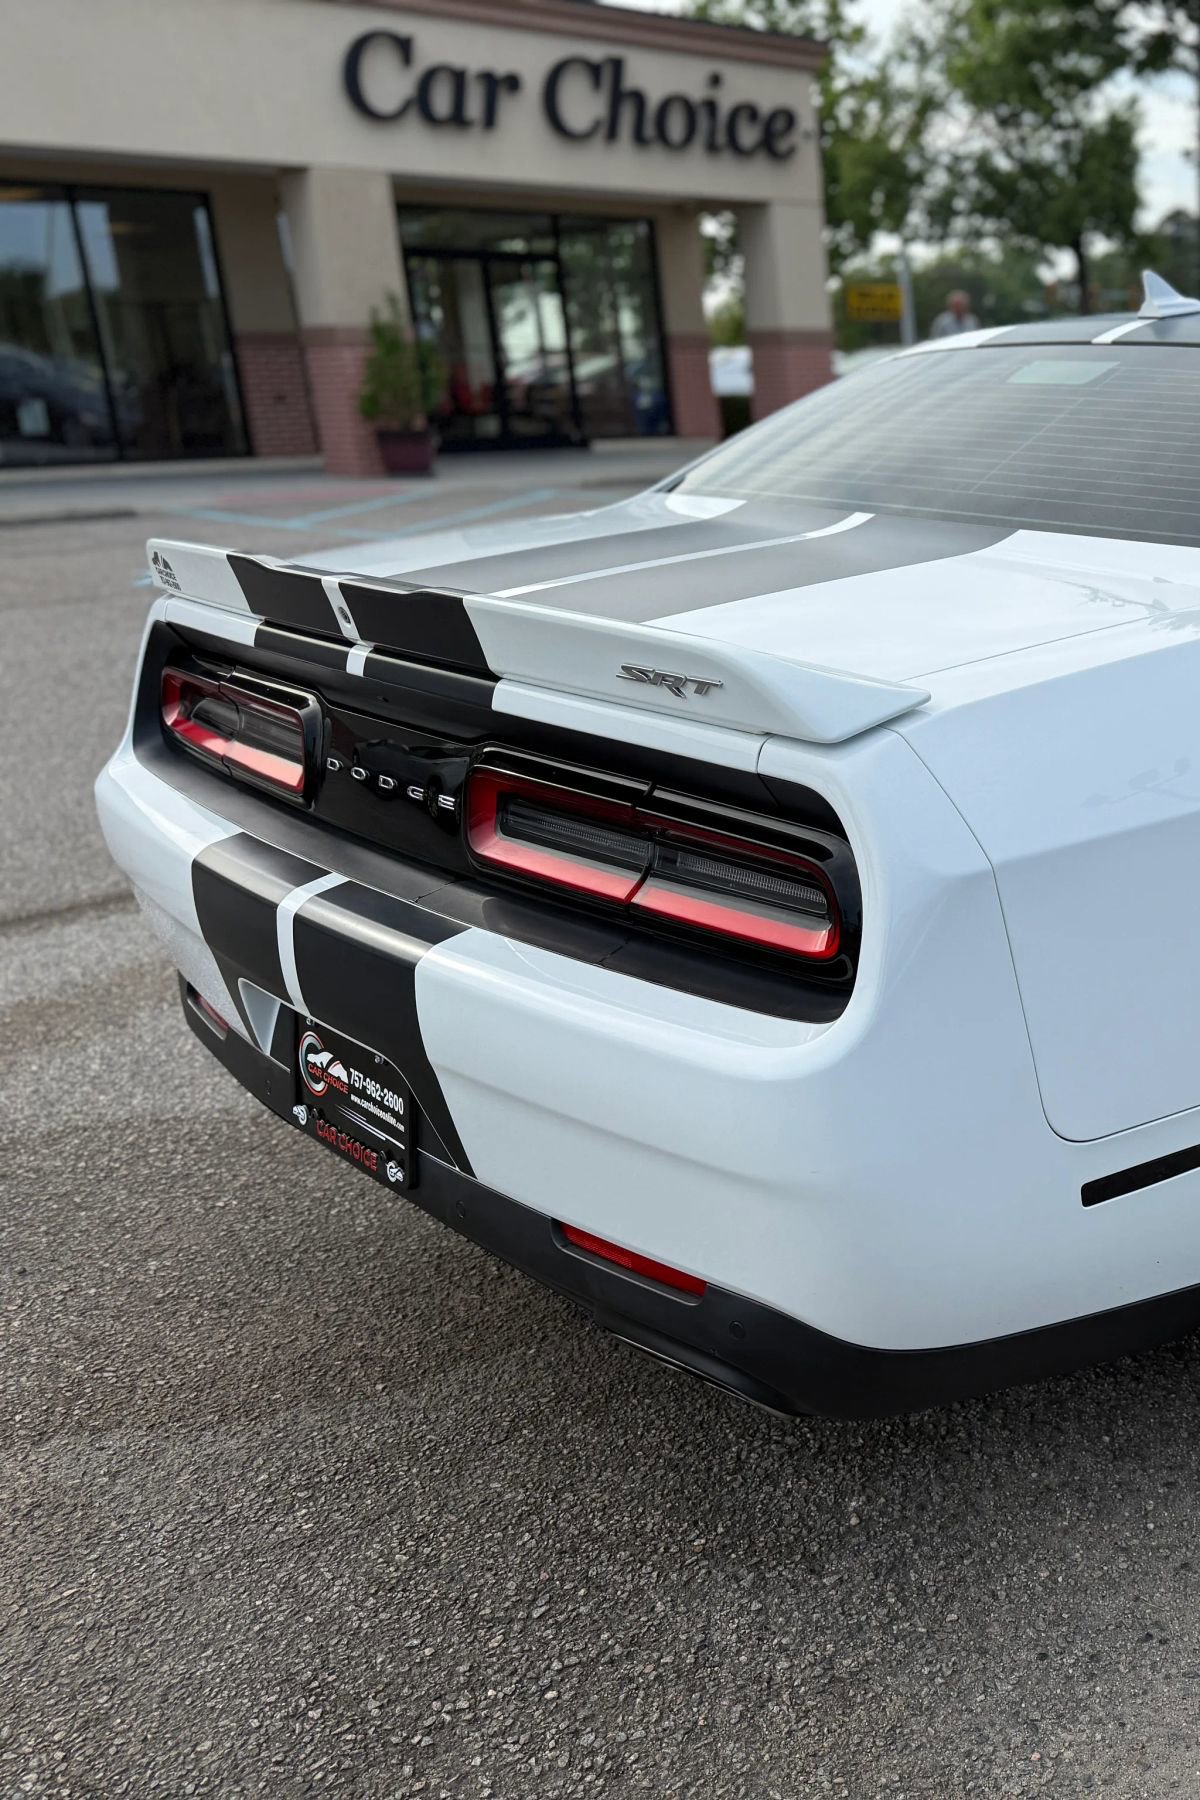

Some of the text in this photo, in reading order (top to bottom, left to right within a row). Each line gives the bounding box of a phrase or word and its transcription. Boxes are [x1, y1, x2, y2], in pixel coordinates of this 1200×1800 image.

[343, 28, 798, 161] Car Choice
[615, 663, 724, 698] SRT
[326, 757, 456, 811] DODGE
[307, 1063, 349, 1095] CAR CHOICE
[349, 1067, 404, 1116] 757-962-2600
[315, 1119, 378, 1173] CAR CHOICE
